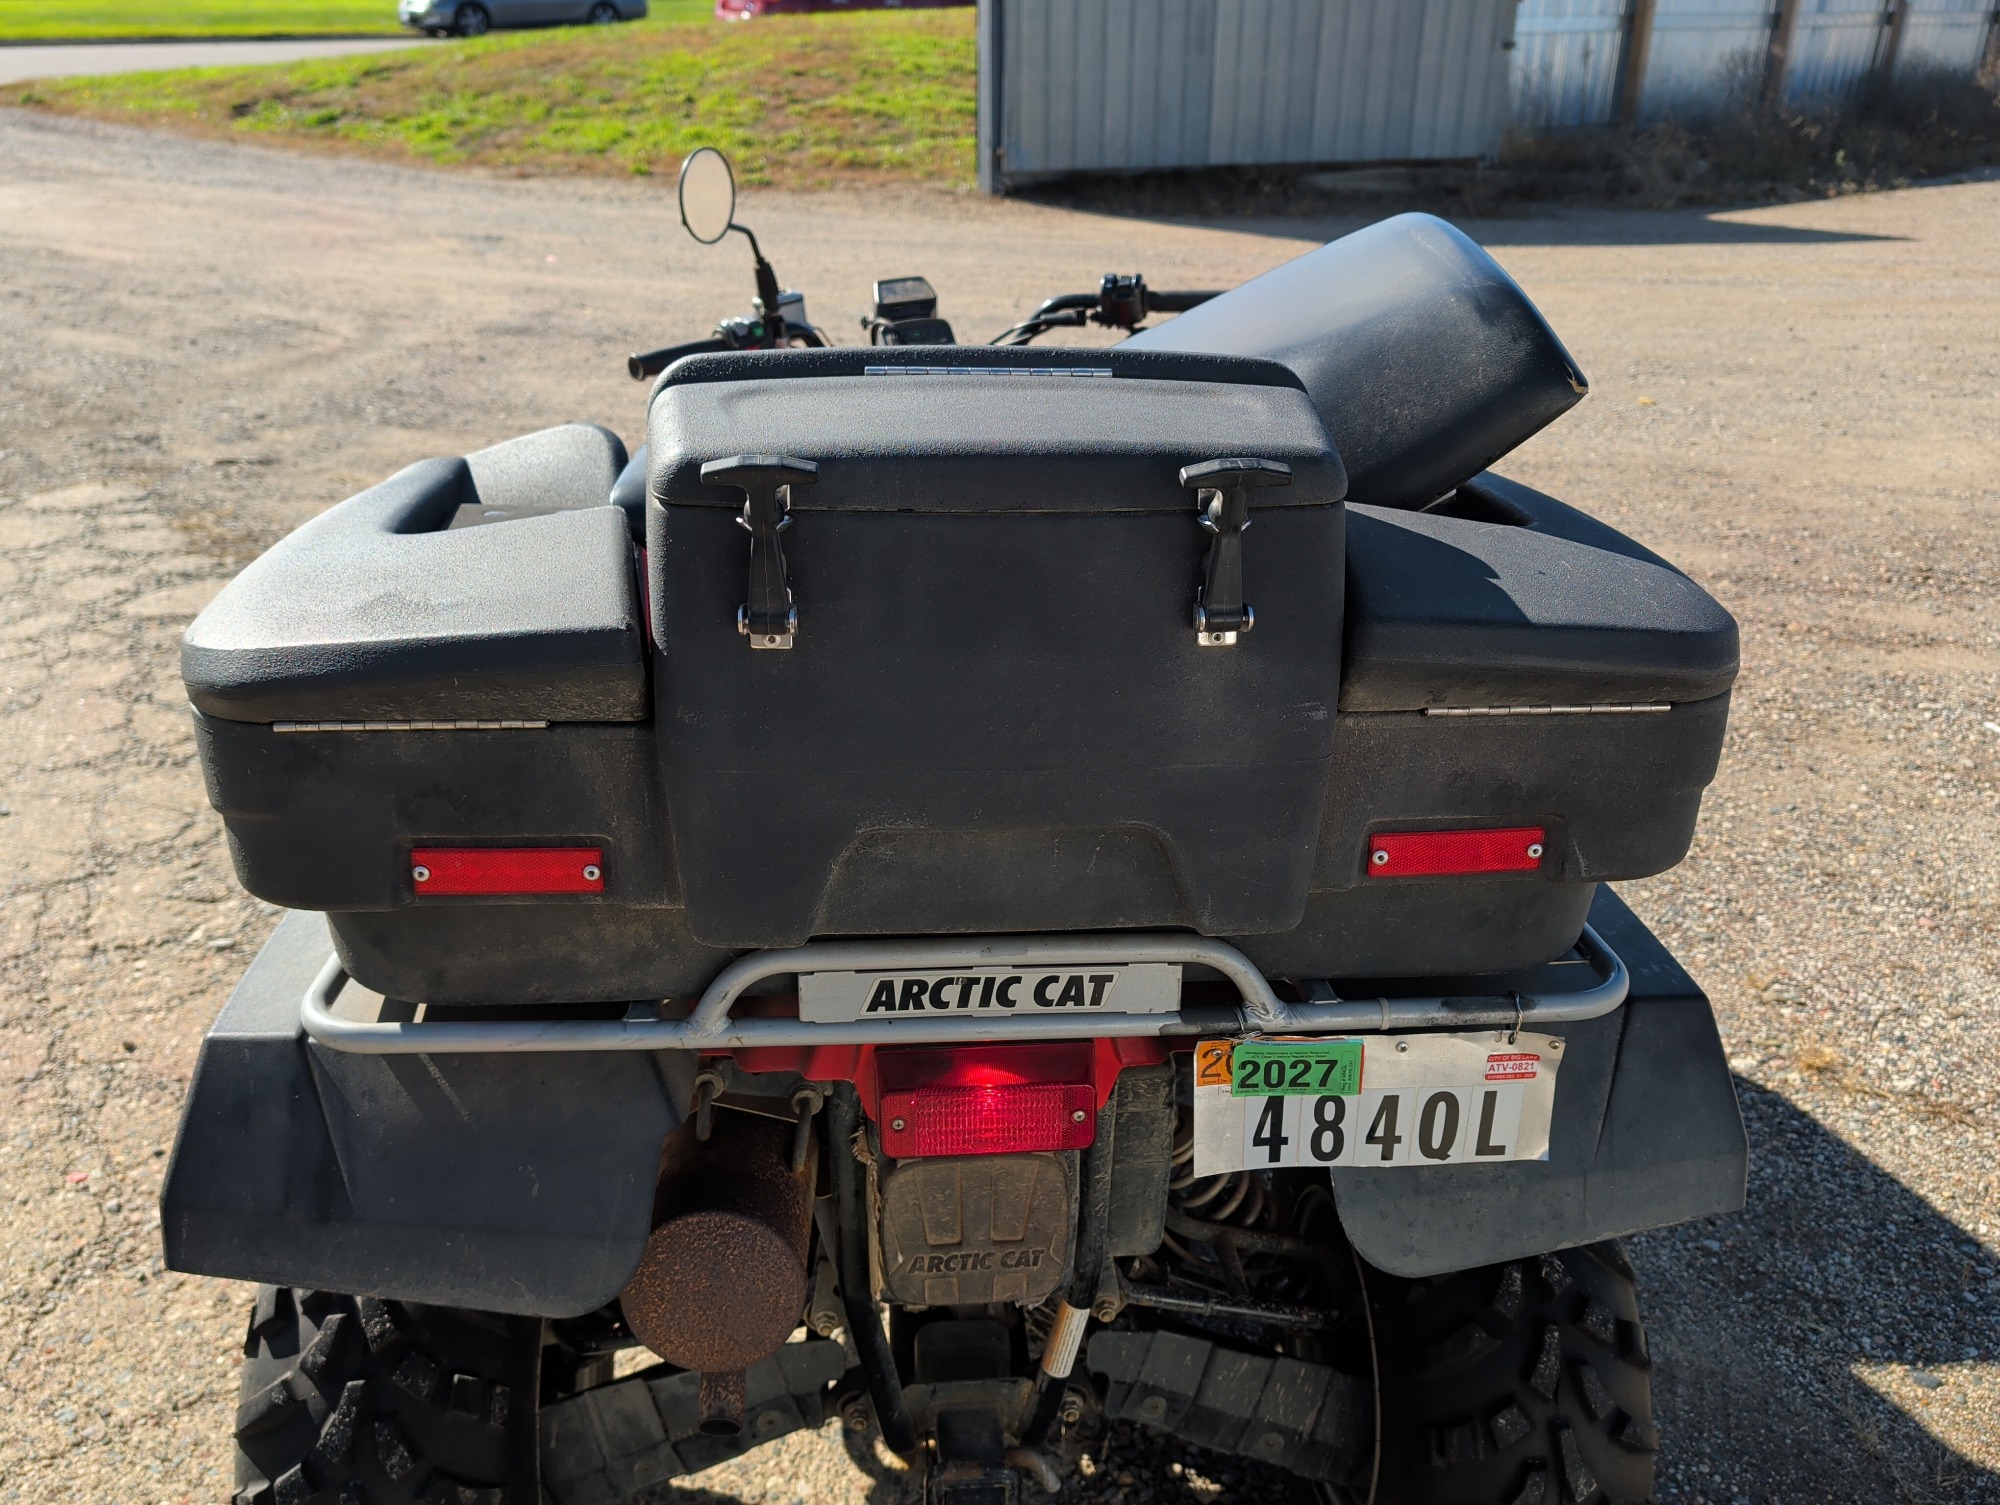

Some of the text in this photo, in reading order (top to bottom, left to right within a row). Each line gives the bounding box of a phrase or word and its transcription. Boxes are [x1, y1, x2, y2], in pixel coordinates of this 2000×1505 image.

[866, 974, 1115, 1012] ARCTIC CAT
[1238, 1059, 1338, 1089] 2027
[1488, 1062, 1534, 1072] ATV-0821
[1252, 1090, 1507, 1163] 484QL
[908, 1249, 1046, 1274] ARCTIC CAT
